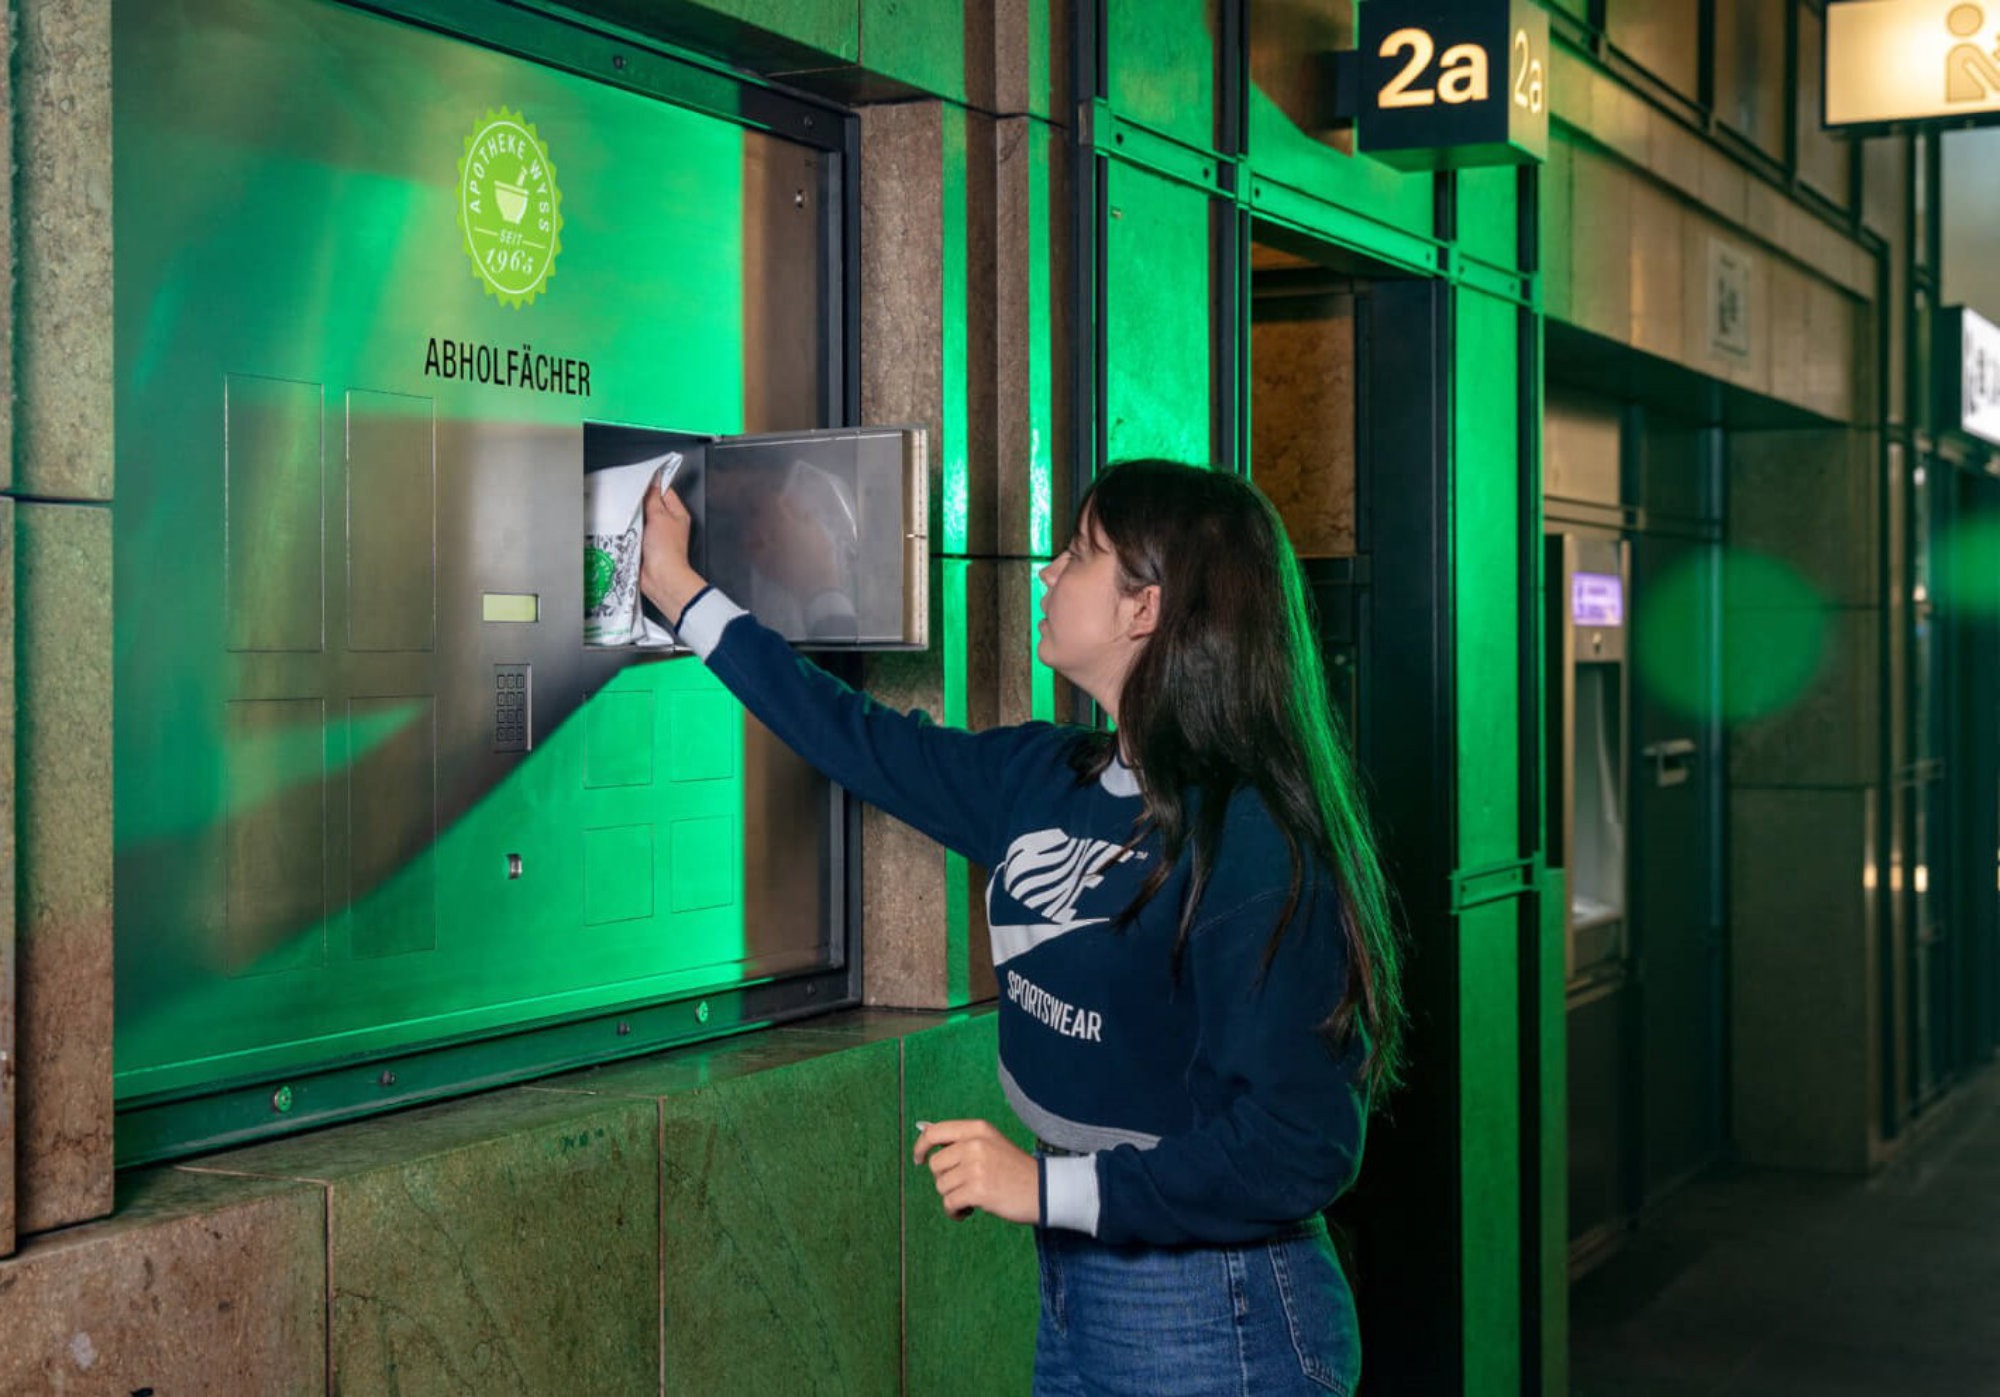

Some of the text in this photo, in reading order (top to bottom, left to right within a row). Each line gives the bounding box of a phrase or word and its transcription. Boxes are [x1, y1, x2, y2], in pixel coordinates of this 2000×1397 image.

[1377, 27, 1489, 109] 2a
[1514, 28, 1543, 114] 2a
[469, 133, 550, 232] APOTHEKE WYSS
[486, 247, 534, 275] 1965
[499, 229, 523, 246] SEIT
[424, 337, 591, 397] ABHOLFÄCHER
[1007, 970, 1103, 1042] SPORTSWEAR
